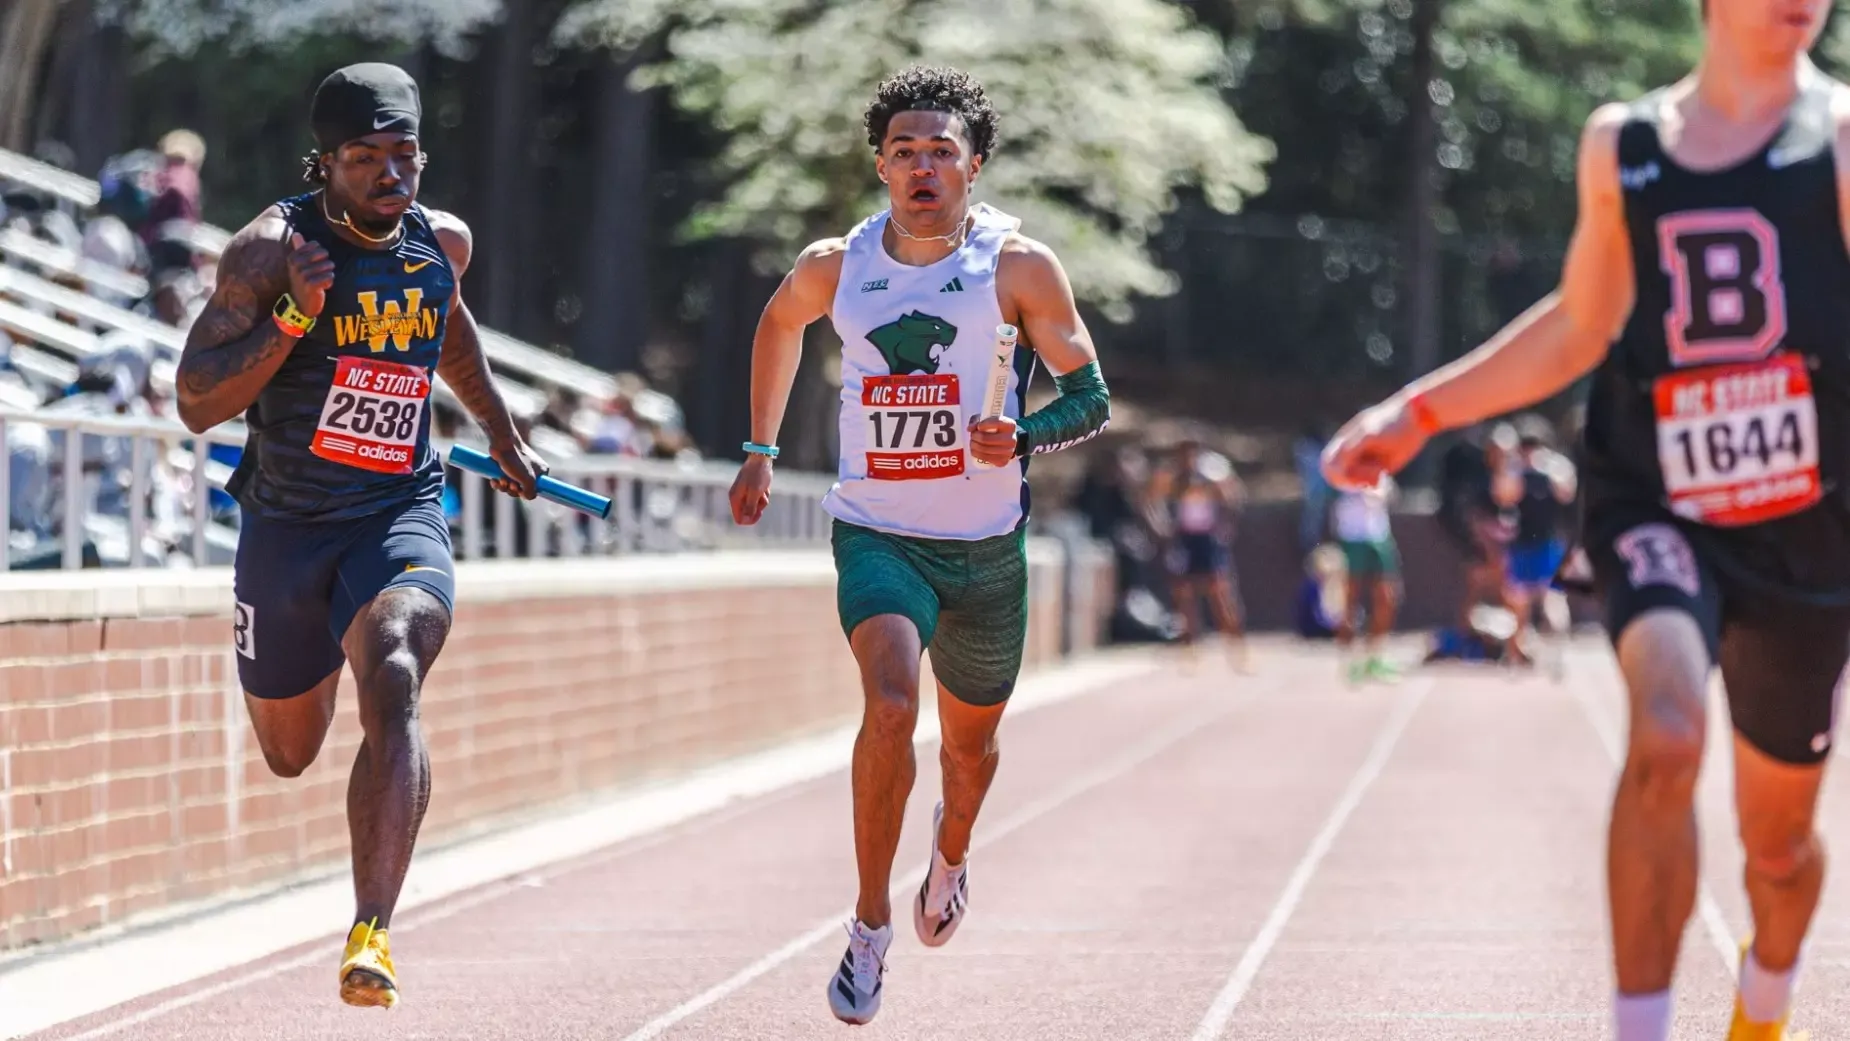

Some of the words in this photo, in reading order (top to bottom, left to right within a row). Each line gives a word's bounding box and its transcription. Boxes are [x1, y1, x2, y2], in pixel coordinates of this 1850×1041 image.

[1656, 208, 1787, 366] B
[357, 288, 424, 353] W
[344, 367, 373, 388] NC
[373, 372, 421, 396] STATE
[871, 385, 892, 404] NC
[896, 384, 948, 404] STATE
[325, 392, 418, 440] 2538
[869, 410, 957, 448] 1773
[358, 445, 408, 463] adidas
[904, 455, 959, 469] adidas
[1677, 411, 1802, 478] 1644
